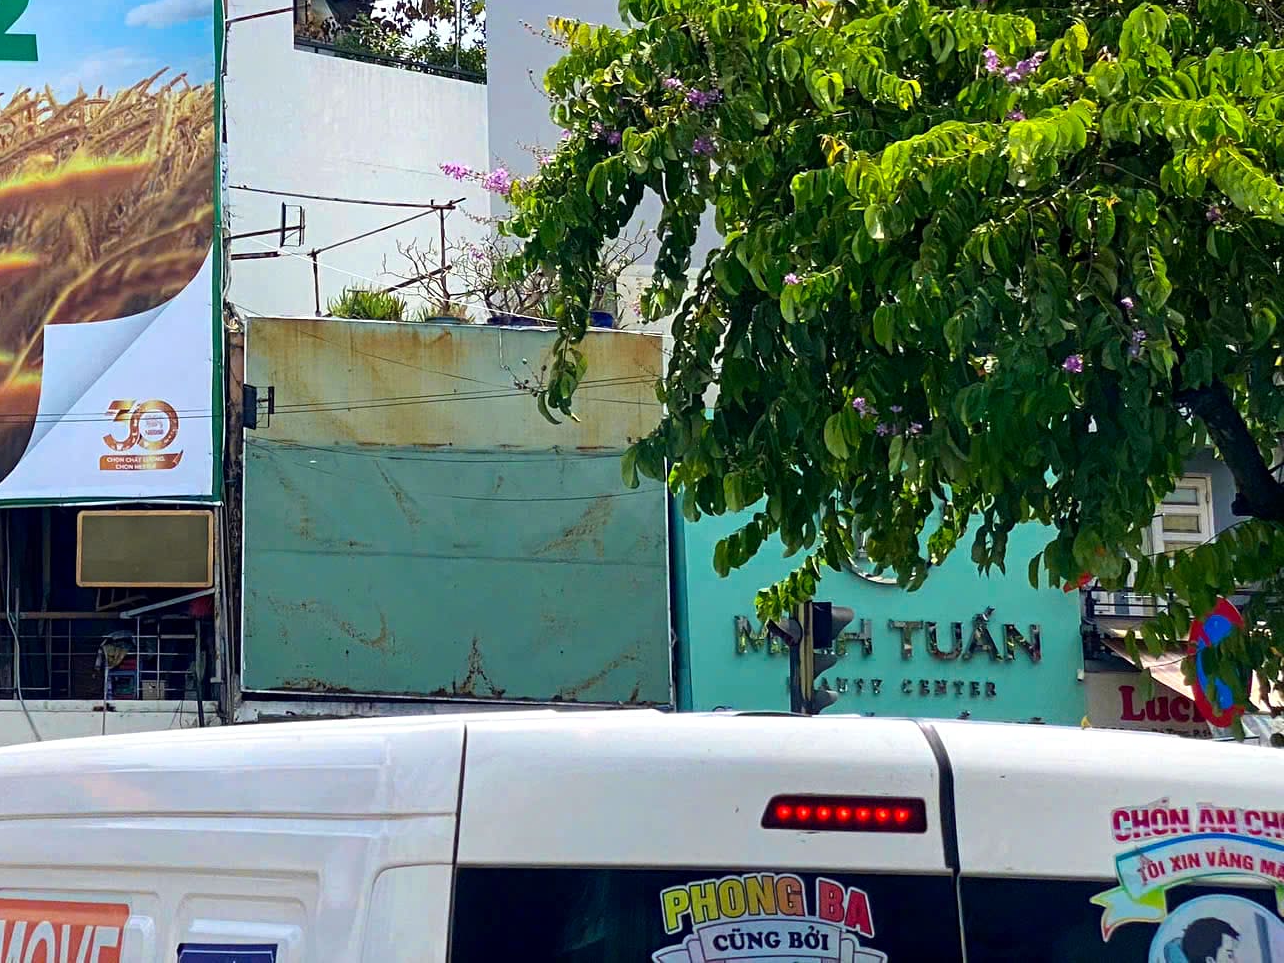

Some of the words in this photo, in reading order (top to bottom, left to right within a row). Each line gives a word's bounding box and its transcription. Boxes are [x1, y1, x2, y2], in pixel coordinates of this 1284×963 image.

[887, 606, 1043, 662] TUẤN
[900, 678, 998, 698] CENTER
[1244, 810, 1284, 838] CH
[1169, 853, 1201, 872] XIN
[661, 874, 806, 932] PHONG
[817, 879, 874, 936] BA
[713, 927, 781, 951] CŨNG
[788, 925, 829, 951] BỞI
